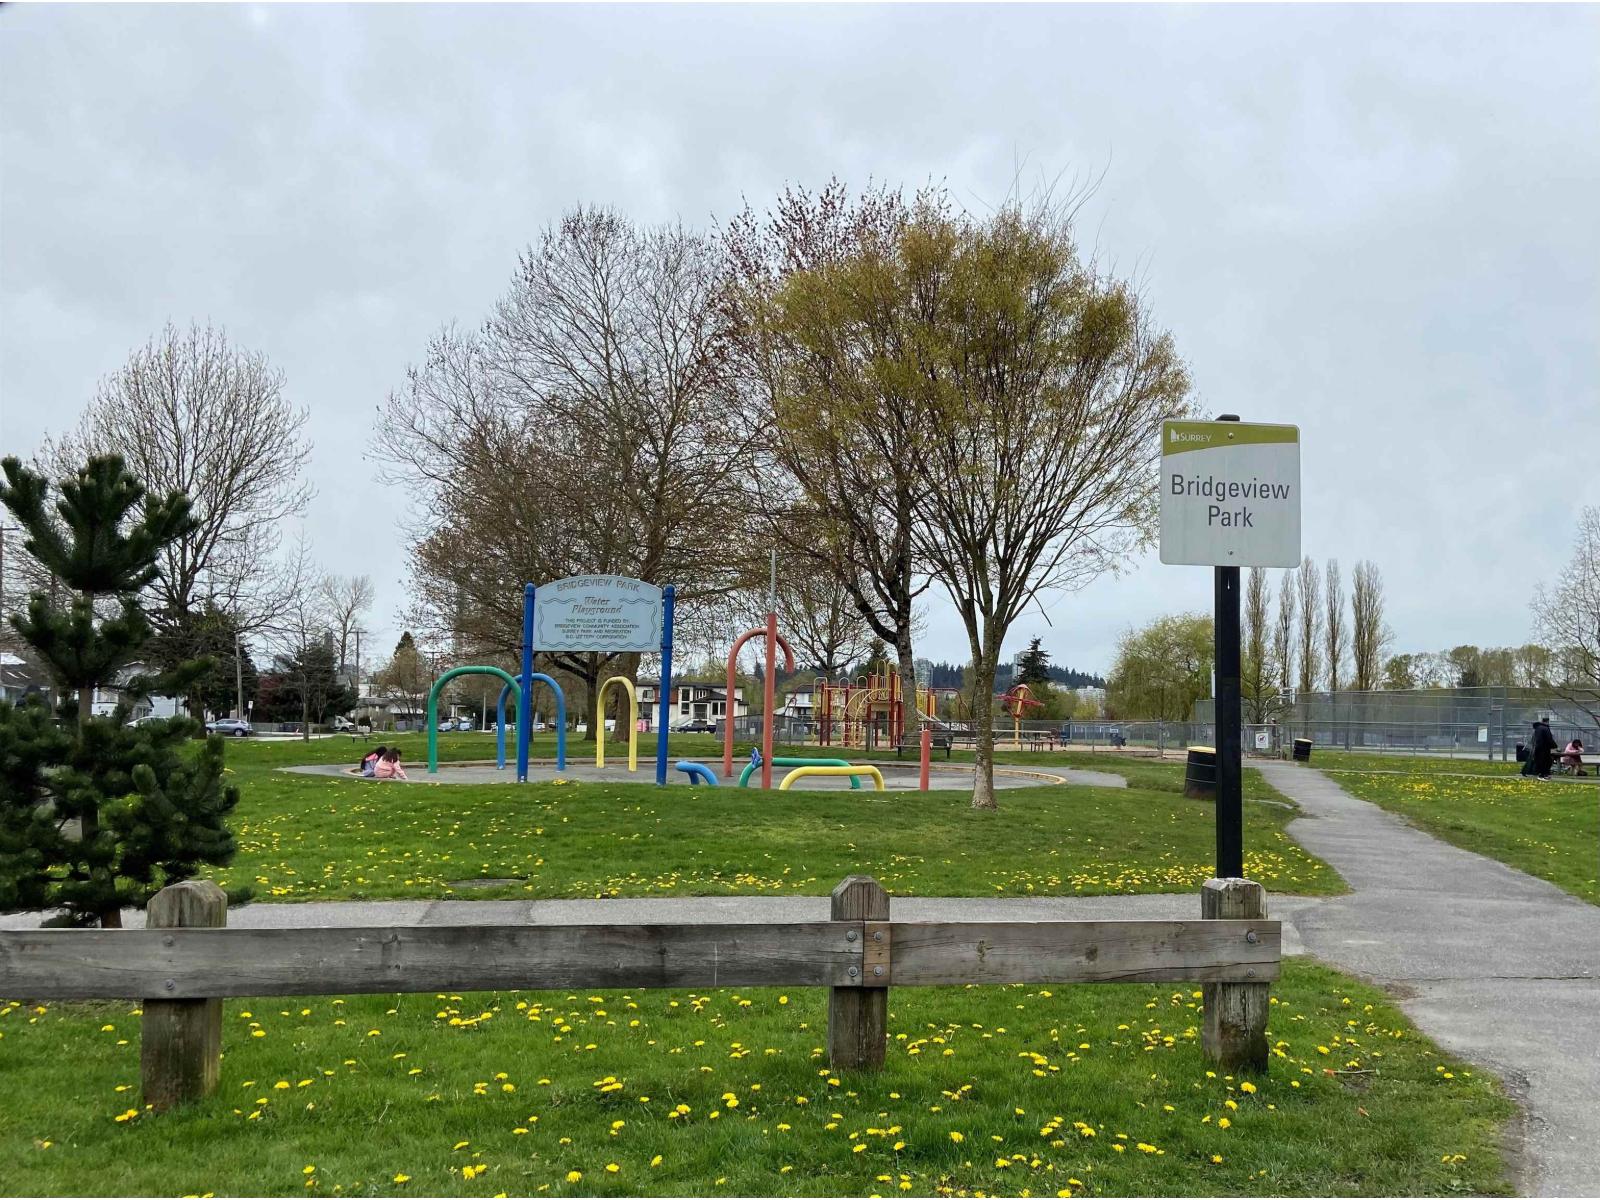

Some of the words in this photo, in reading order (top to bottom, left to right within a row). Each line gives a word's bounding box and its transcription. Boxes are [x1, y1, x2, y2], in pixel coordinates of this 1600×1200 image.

[1180, 432, 1212, 442] SURREY
[1171, 474, 1290, 502] Bridgeview
[1208, 505, 1254, 528] Park
[556, 578, 613, 592] BRIDGEVIEW
[616, 580, 640, 592] PARK
[584, 596, 610, 605] Water
[571, 604, 623, 615] Playground
